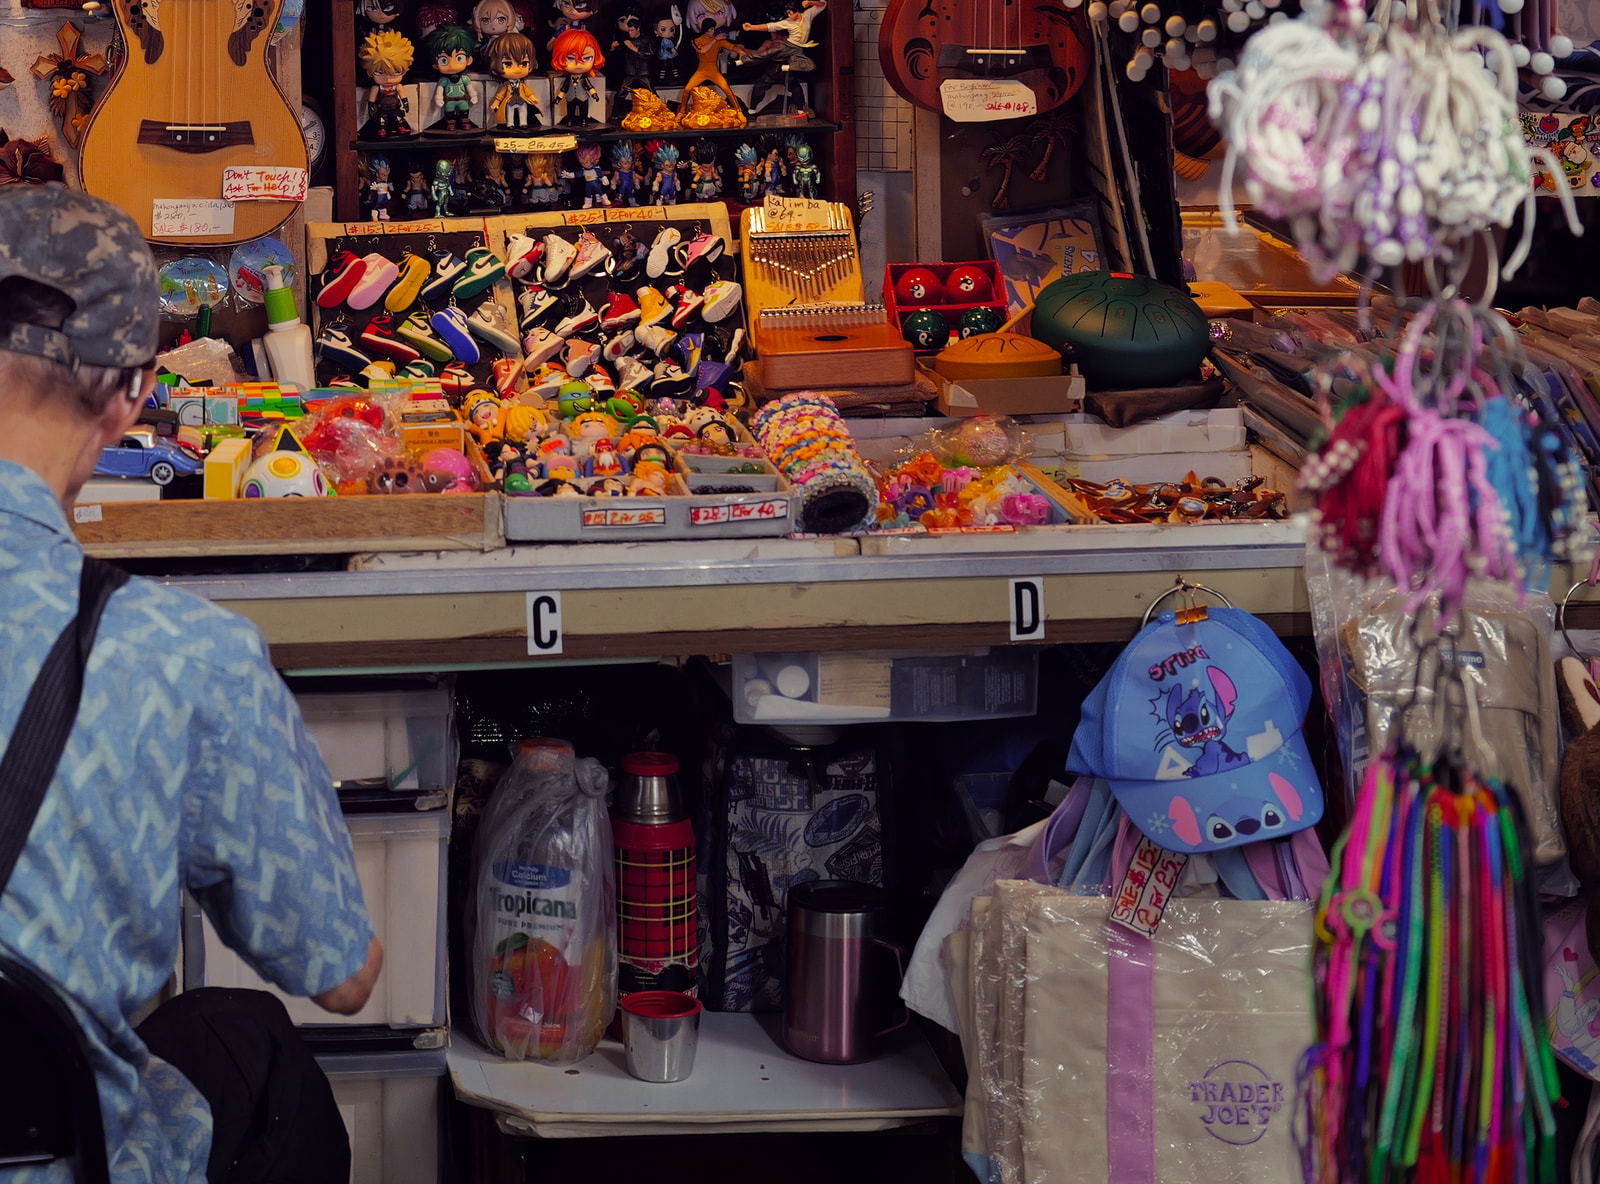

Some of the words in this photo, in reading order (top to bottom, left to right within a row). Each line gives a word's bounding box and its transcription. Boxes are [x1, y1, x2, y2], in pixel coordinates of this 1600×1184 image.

[256, 170, 297, 183] Touch!
[225, 183, 244, 192] Ask
[264, 182, 296, 196] Help!
[153, 224, 175, 234] SALE
[1063, 245, 1076, 276] AKERS
[1014, 581, 1039, 635] D
[532, 595, 559, 650] C
[1441, 653, 1483, 665] Sureme
[511, 870, 547, 881] Calcium
[490, 887, 576, 918] Tropicana
[1116, 886, 1138, 921] SALE
[1137, 909, 1159, 927] 2
[1187, 1081, 1285, 1103] TRADER
[1200, 1104, 1272, 1125] JOE'S
